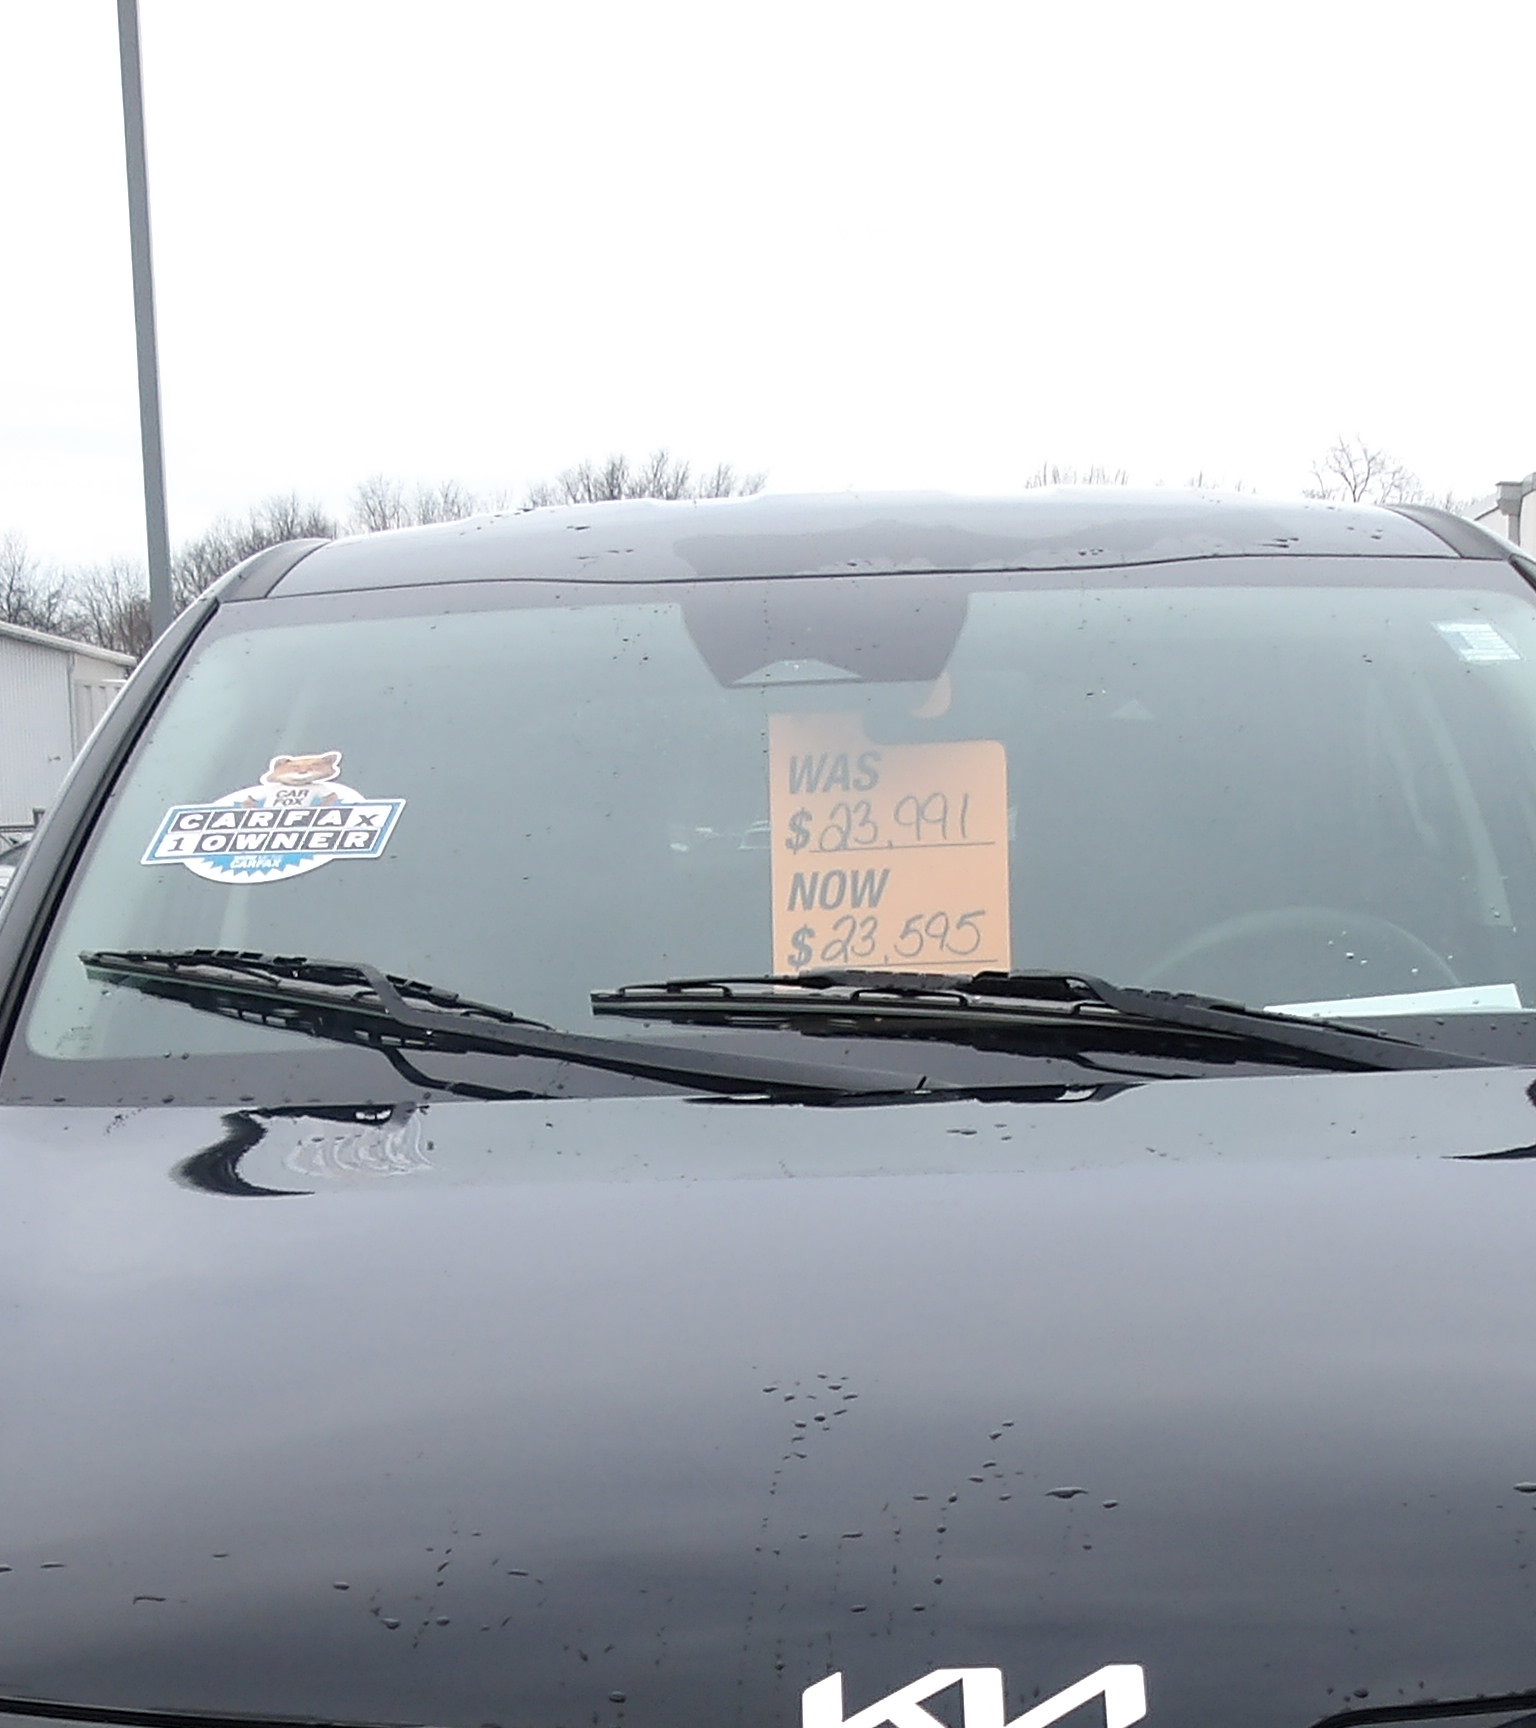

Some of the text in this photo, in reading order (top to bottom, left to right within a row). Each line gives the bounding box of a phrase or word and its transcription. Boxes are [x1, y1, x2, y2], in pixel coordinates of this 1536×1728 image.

[788, 750, 883, 795] WAS
[175, 809, 381, 831] CARFAX
[167, 830, 373, 852] 1 OWNER
[787, 867, 891, 912] NOW
